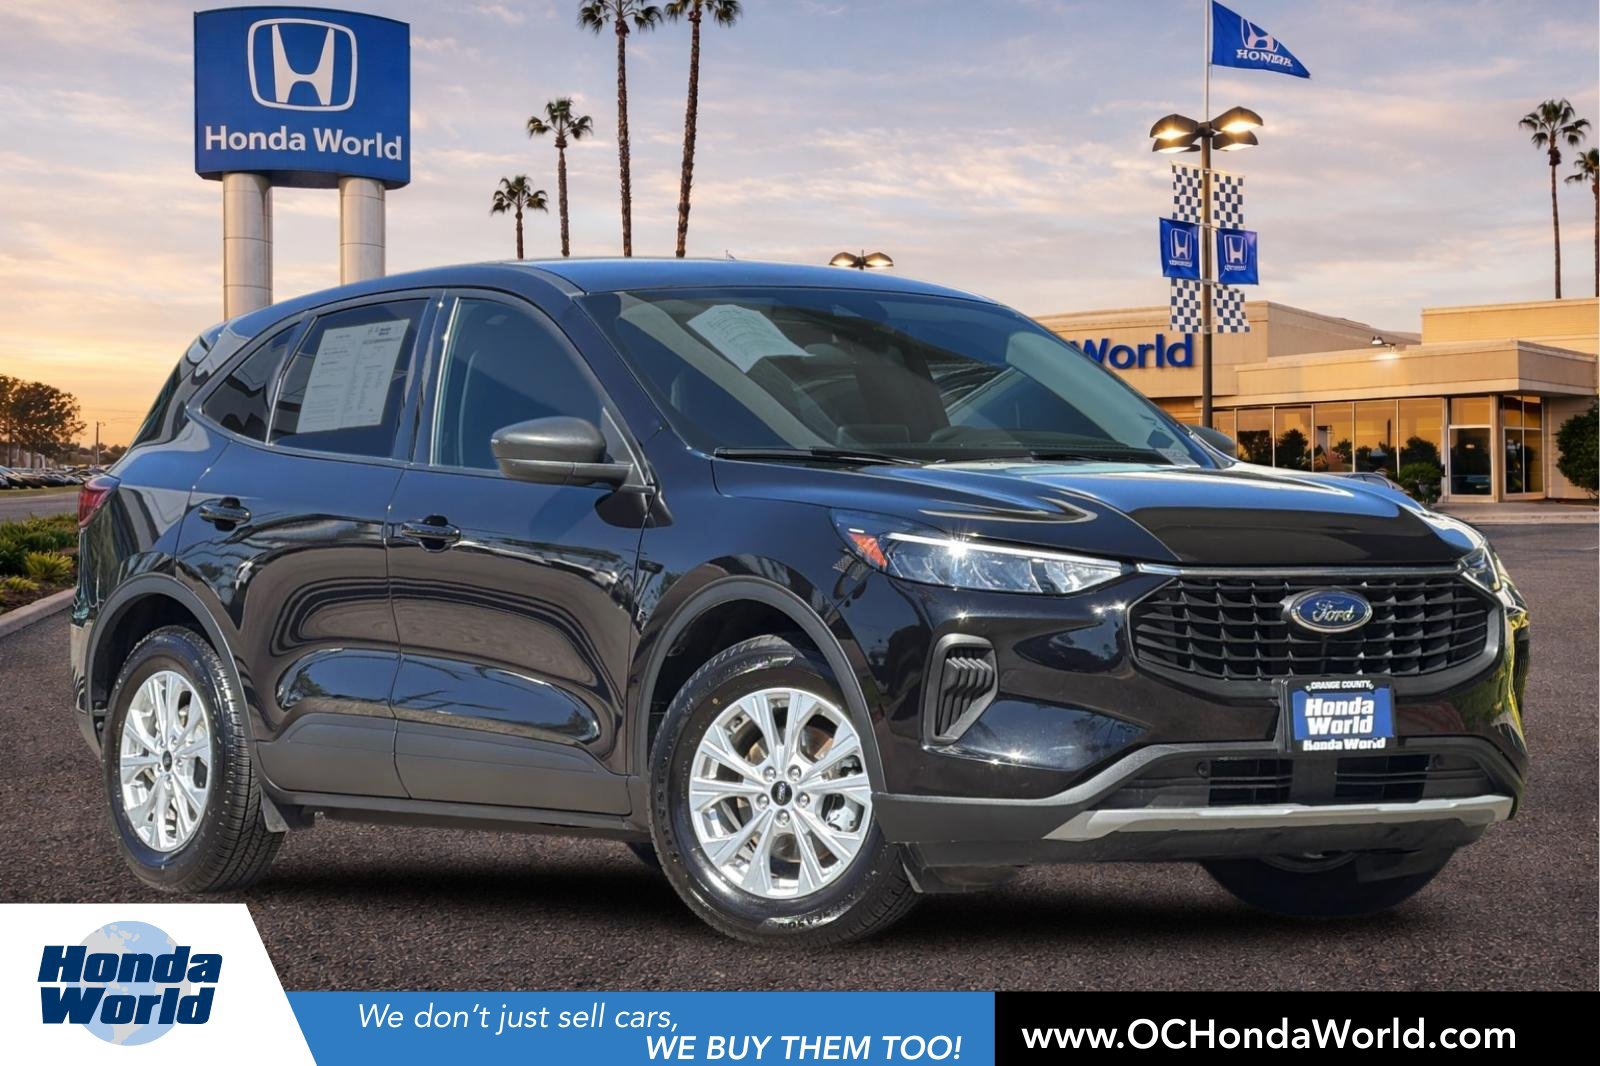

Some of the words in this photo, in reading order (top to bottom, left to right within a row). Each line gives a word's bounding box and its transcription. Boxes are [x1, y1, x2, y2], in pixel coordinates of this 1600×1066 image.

[205, 125, 306, 151] Honda
[313, 127, 402, 161] World
[1312, 600, 1355, 622] Ford
[1310, 681, 1340, 690] ORANGE
[1341, 680, 1371, 690] COUNTY
[1305, 696, 1375, 717] Honda
[1307, 715, 1374, 735] World
[1302, 739, 1343, 752] Honda
[1343, 737, 1386, 750] World
